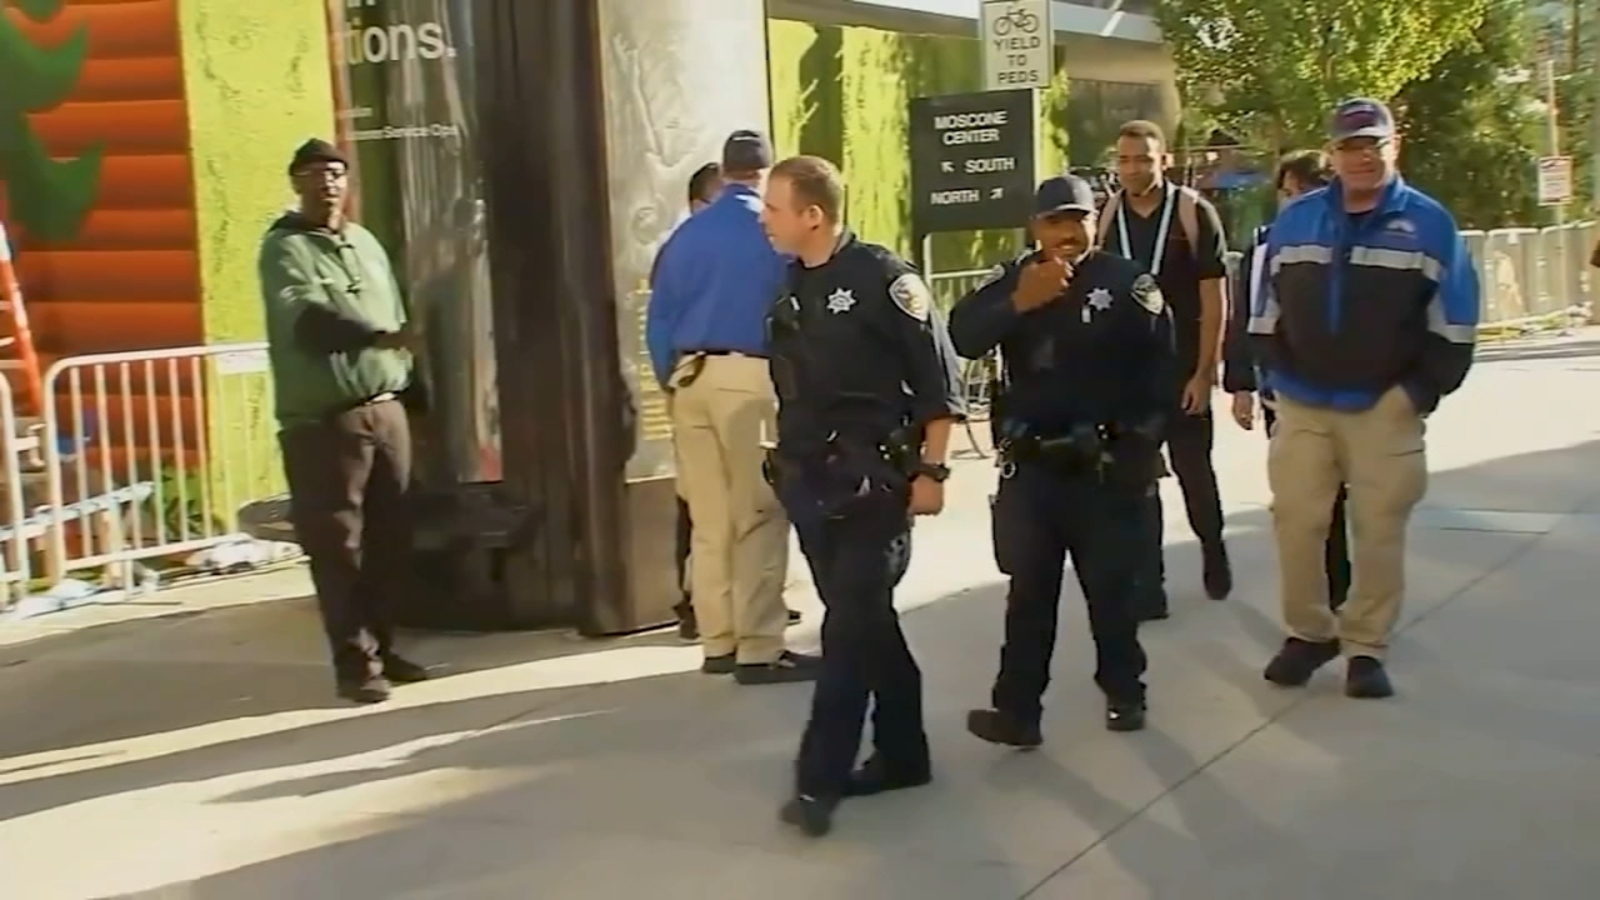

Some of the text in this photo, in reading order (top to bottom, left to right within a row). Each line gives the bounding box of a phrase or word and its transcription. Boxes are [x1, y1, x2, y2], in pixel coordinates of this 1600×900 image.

[994, 36, 1040, 51] YIELD
[1006, 54, 1027, 67] TO
[998, 70, 1039, 84] PEDS
[934, 110, 1007, 129] MOSCONE
[943, 129, 1000, 145] CENTER
[965, 157, 1015, 173] SOUTH
[930, 189, 980, 205] NORTH
